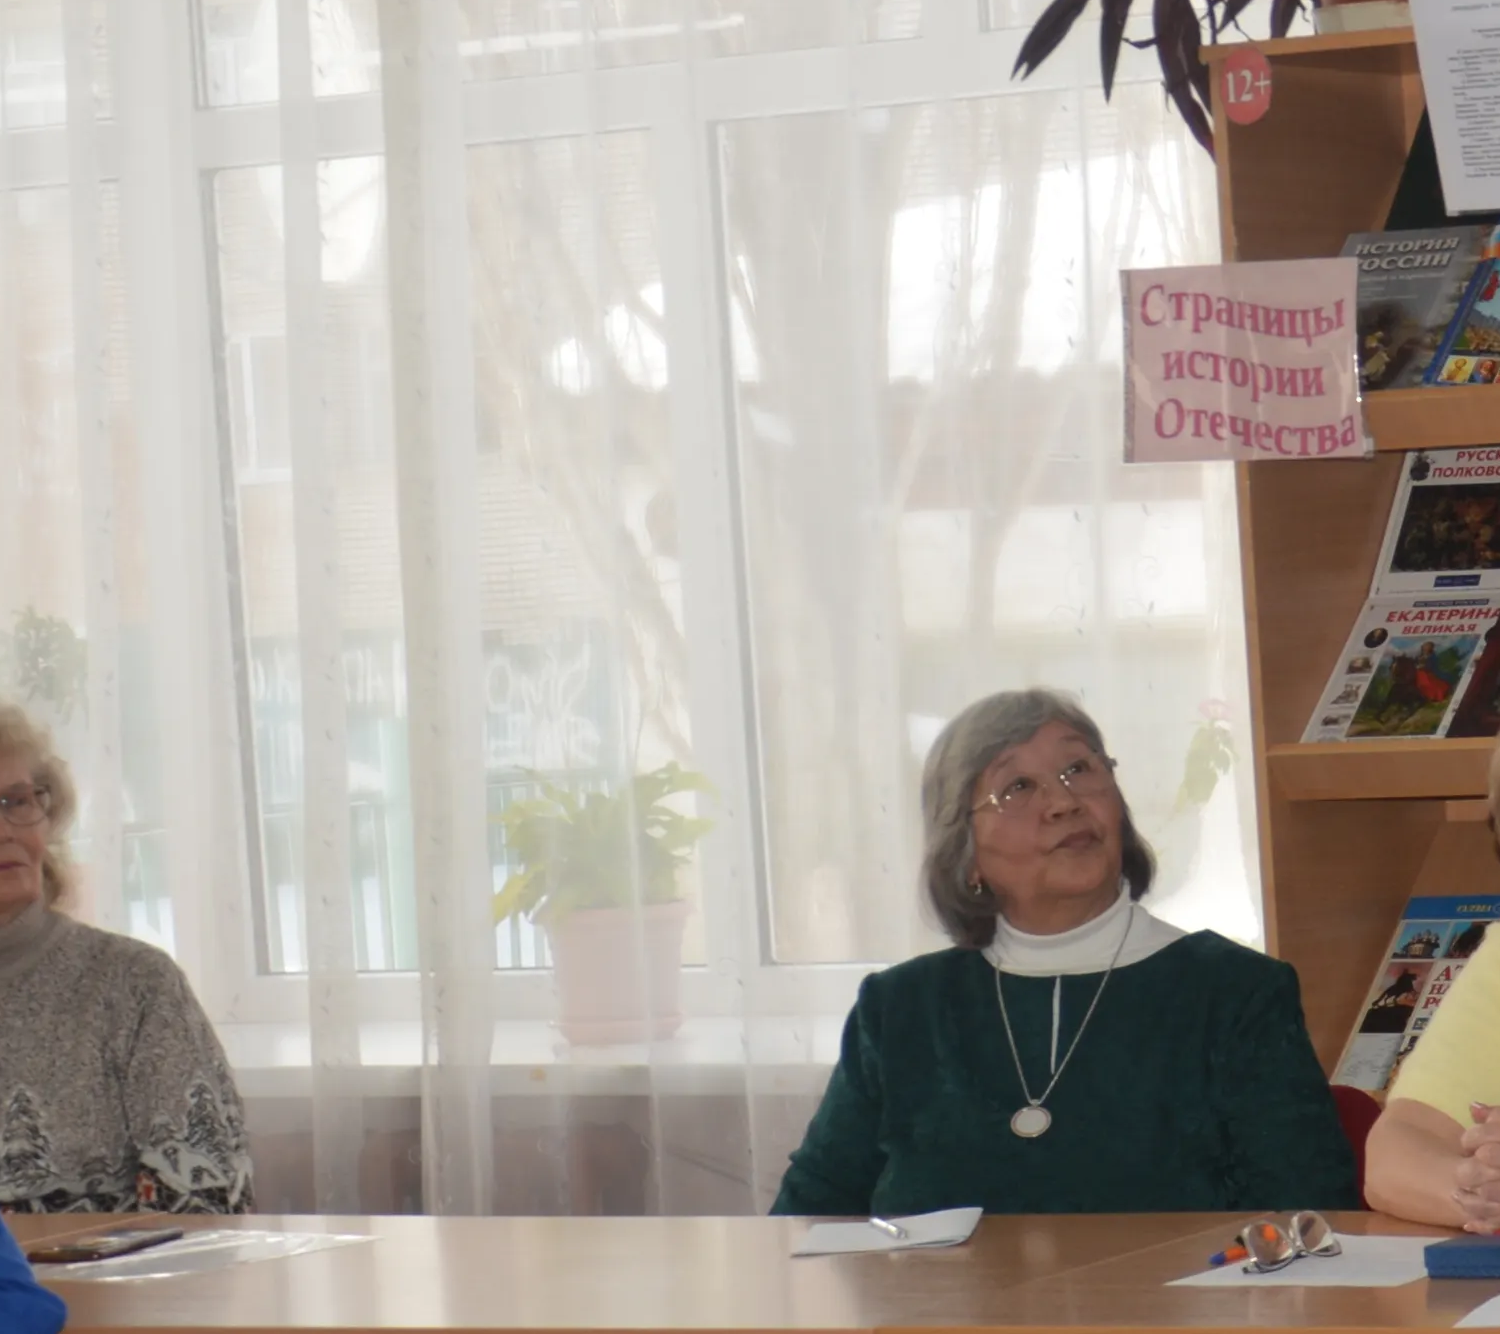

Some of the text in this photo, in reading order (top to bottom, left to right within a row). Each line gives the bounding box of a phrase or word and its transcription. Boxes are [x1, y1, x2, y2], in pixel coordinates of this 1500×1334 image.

[1226, 70, 1270, 103] 12+
[1356, 237, 1460, 256] ИСТОРИЯ
[1358, 253, 1452, 271] ОССИИ
[1140, 284, 1345, 347] Страницы
[1162, 350, 1325, 402] истории
[1154, 398, 1356, 457] Отечества
[1402, 623, 1477, 635] ВЕЛИКАЯ
